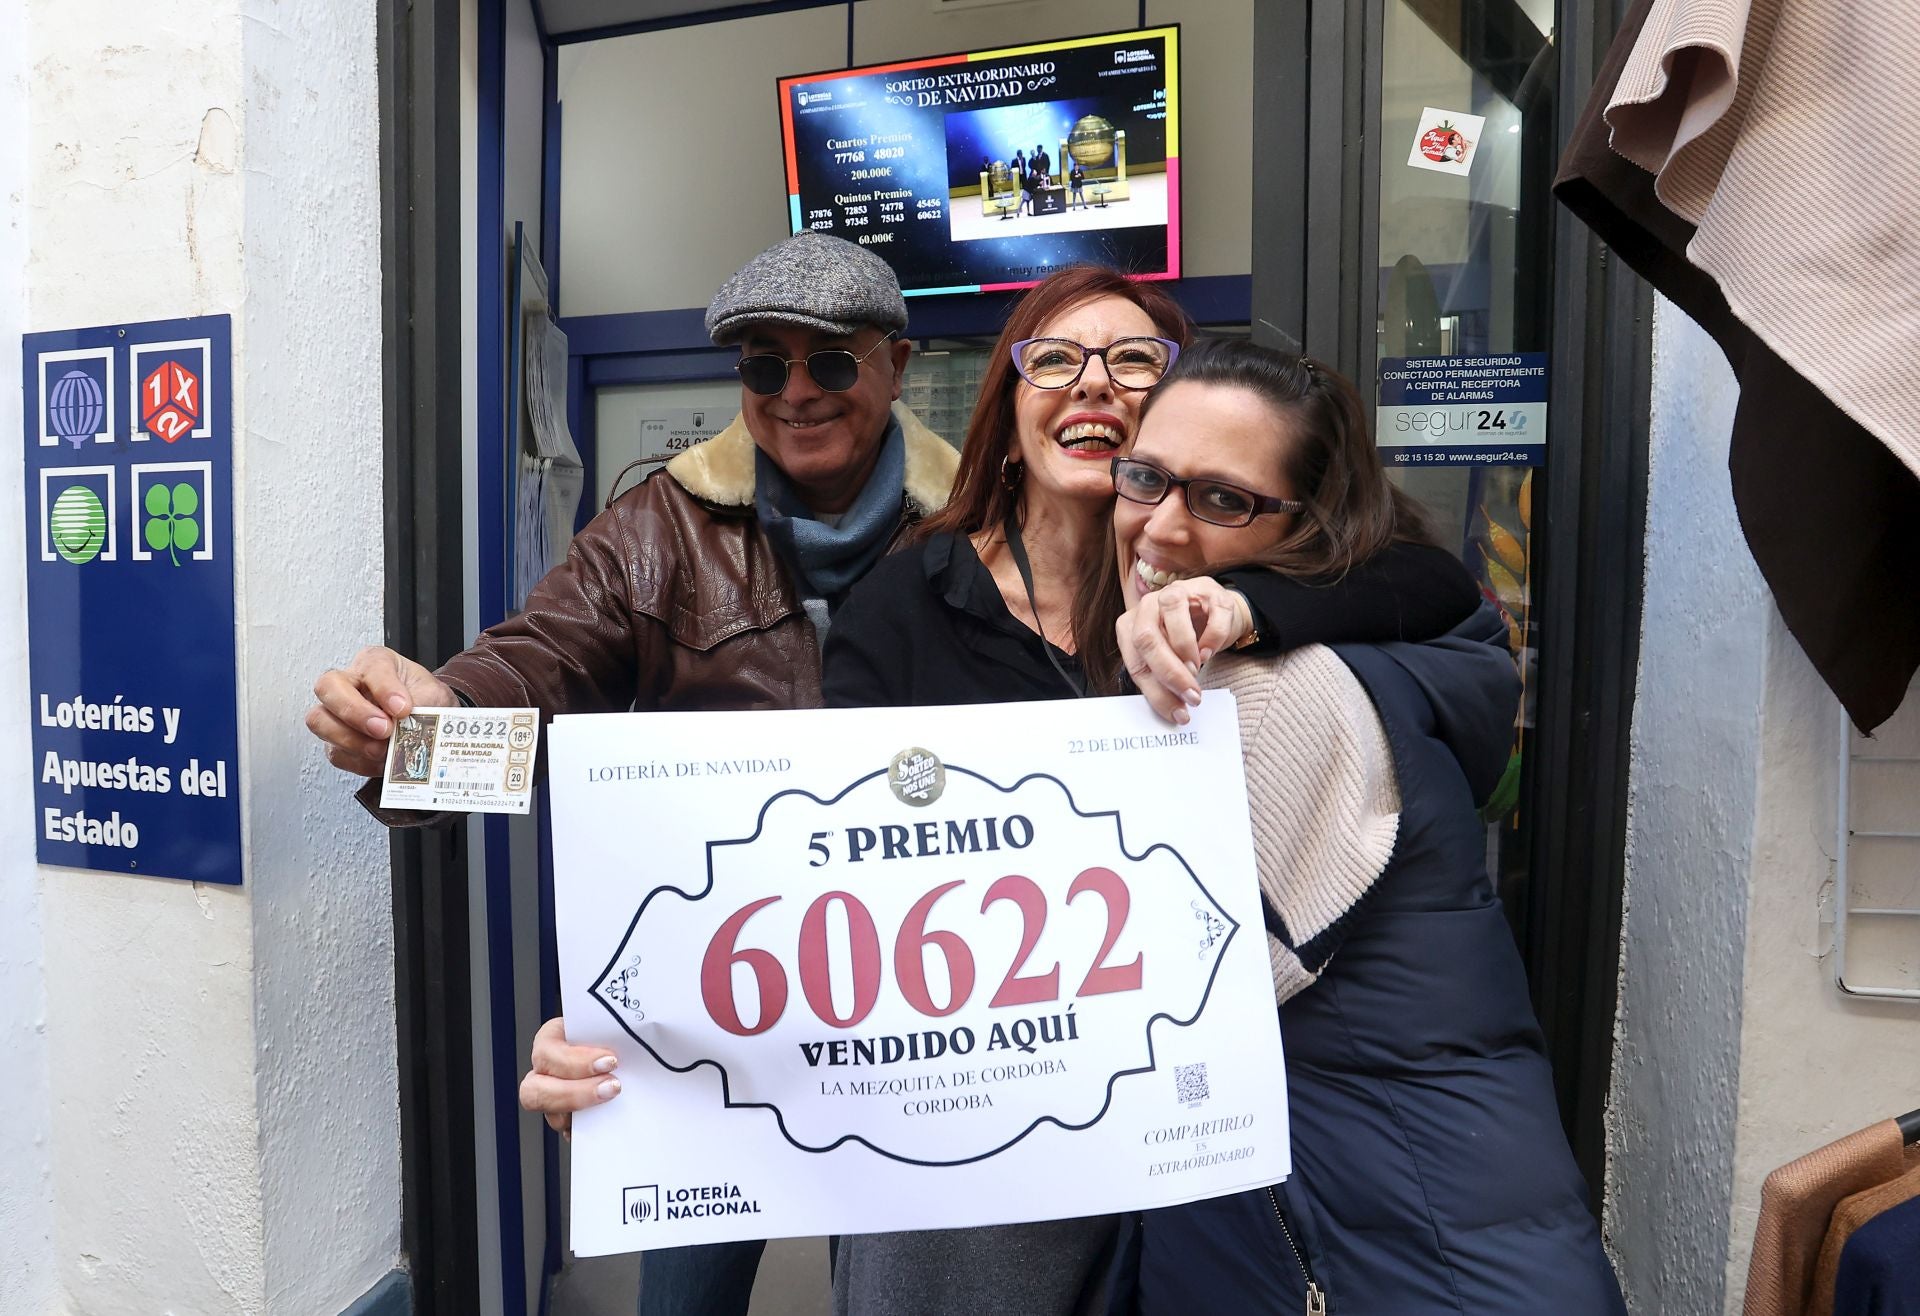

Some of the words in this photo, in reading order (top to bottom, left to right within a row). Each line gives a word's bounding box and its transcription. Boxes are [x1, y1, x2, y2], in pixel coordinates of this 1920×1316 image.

[886, 77, 936, 94] SORTEO
[938, 61, 1056, 88] EXTRAORDINARIO
[917, 90, 940, 107] DE
[945, 80, 1023, 104] NAVIDAD
[827, 139, 868, 150] Cuartos
[870, 133, 913, 145] Premios
[835, 151, 865, 164] 77768
[873, 147, 904, 160] 48020
[851, 167, 893, 180] 200.000€
[834, 193, 872, 205] Quintos
[873, 188, 913, 200] Premios
[809, 209, 832, 219] 37876
[844, 206, 867, 215] 72853
[880, 202, 904, 211] 74778
[917, 199, 941, 209] 45456
[810, 220, 833, 230] 45225
[845, 217, 869, 226] 97345
[881, 214, 904, 223] 75143
[917, 210, 941, 220] 60622
[858, 233, 894, 244] 60.000€
[1383, 371, 1443, 380] CONECTADO
[1445, 368, 1545, 379] PERMANENTEMENTE
[1406, 359, 1447, 369] SISTEMA
[1450, 359, 1463, 367] DE
[1464, 357, 1522, 367] SEGURIDAD
[149, 373, 161, 407] 1
[1406, 382, 1413, 390] A
[1414, 381, 1459, 390] CENTRAL
[1461, 379, 1521, 389] RECEPTORA
[1431, 392, 1444, 400] DE
[1446, 391, 1494, 400] ALARMAS
[157, 411, 190, 439] 2
[1395, 410, 1507, 437] segur24
[1394, 454, 1410, 462] 902
[1411, 454, 1422, 462] 15
[1435, 453, 1446, 461] 20
[1449, 452, 1528, 463] www.segur24.es
[40, 693, 155, 733] Loterías
[162, 707, 181, 744] y
[442, 720, 507, 736] 60622
[440, 741, 468, 749] LOTERÍA
[471, 742, 504, 750] NACIONAL
[1068, 740, 1085, 754] 22
[1089, 738, 1109, 752] DE
[1113, 731, 1199, 751] DICIEMBRE
[42, 751, 172, 794] Apuestas
[180, 758, 227, 798] del
[511, 773, 521, 783] 20
[588, 760, 670, 783] LOTERÍA
[676, 762, 700, 778] DE
[706, 758, 791, 775] NAVIDAD
[897, 756, 935, 780] SORTEO
[902, 781, 918, 796] NOS
[918, 773, 936, 789] UNE
[44, 807, 139, 849] Estado
[845, 814, 1035, 862] PREMIO
[699, 865, 1145, 1037] 60622
[799, 1026, 976, 1067] VENDIDO
[986, 1003, 1080, 1055] AQUÍ
[820, 1081, 844, 1096] LA
[850, 1074, 947, 1096] MEZQUITA
[953, 1071, 977, 1087] DE
[981, 1058, 1068, 1083] CORDOBA
[903, 1093, 994, 1117] CORDOBA
[1144, 1113, 1255, 1146] COMPARTIRLO
[1195, 1142, 1208, 1152] ES
[1148, 1145, 1256, 1177] EXTRAORDINARIO
[667, 1182, 742, 1203] LOTERÍA
[667, 1200, 762, 1220] NACIONAL
